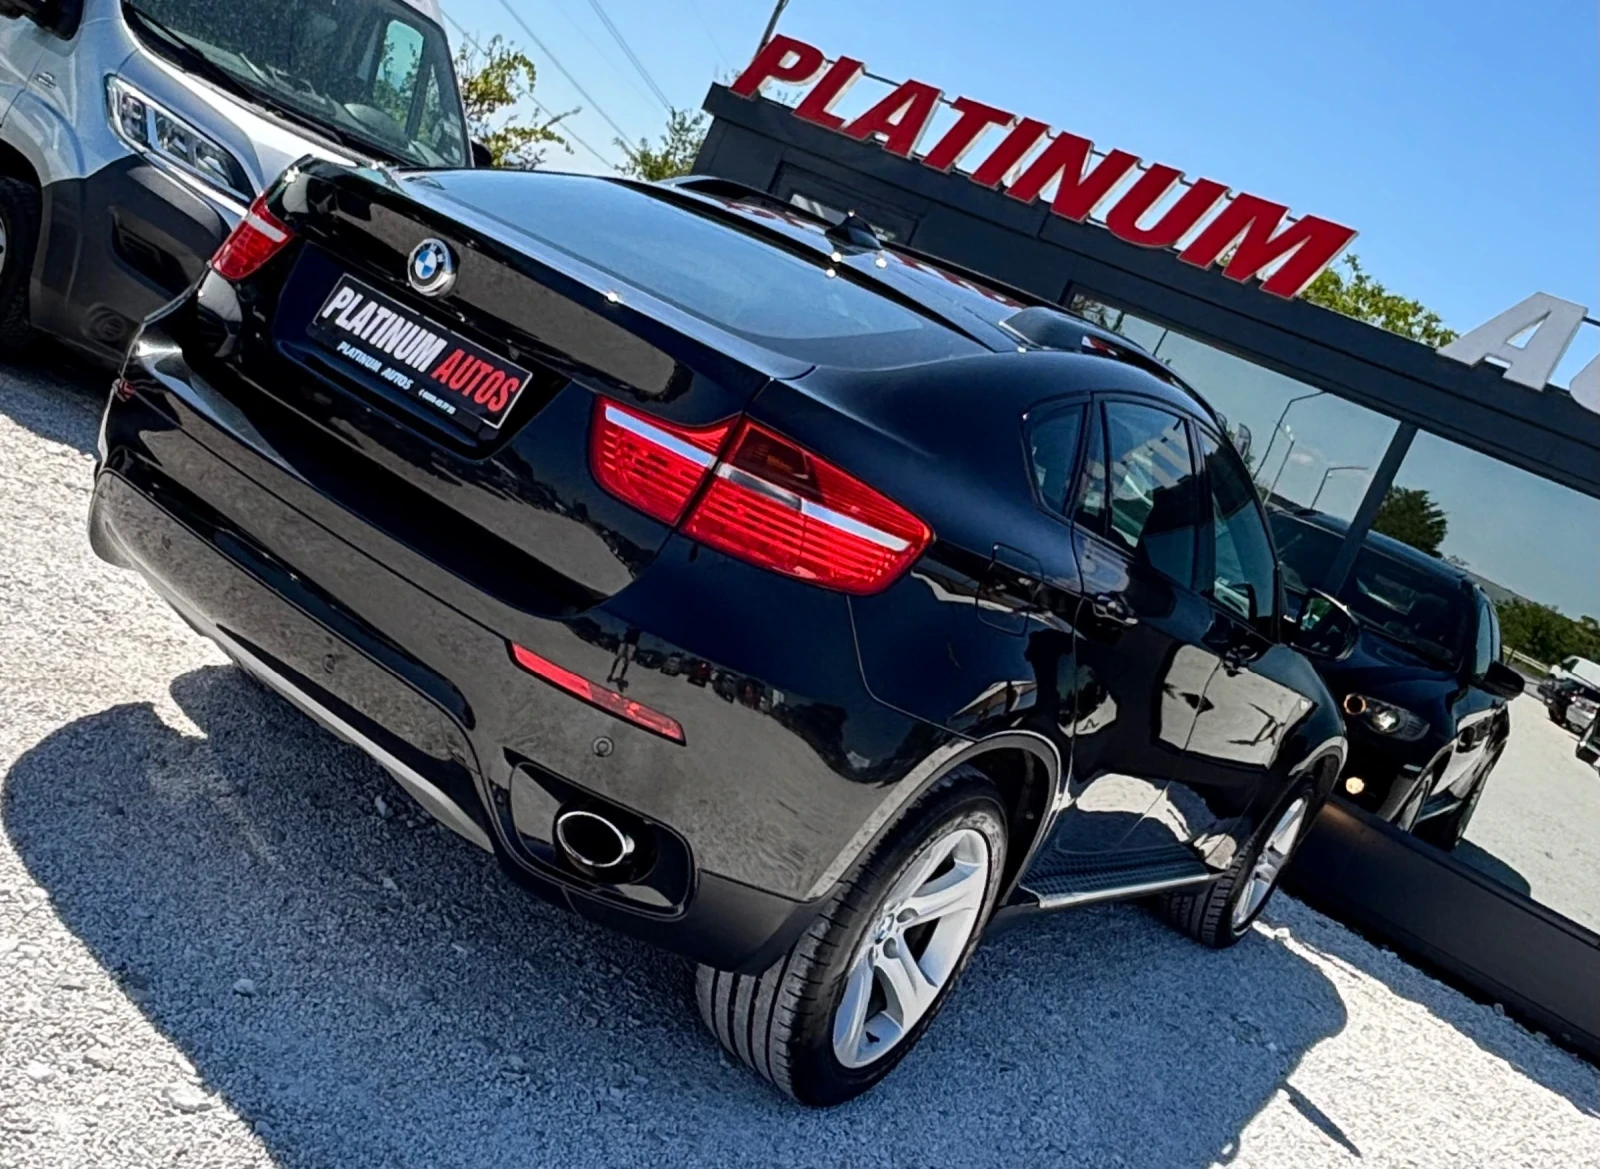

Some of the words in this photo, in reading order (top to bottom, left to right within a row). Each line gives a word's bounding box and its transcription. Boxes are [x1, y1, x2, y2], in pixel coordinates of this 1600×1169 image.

[728, 34, 1358, 299] PLATINUM
[321, 286, 448, 373] PLATINUM
[430, 348, 520, 412] AUTOS
[336, 341, 383, 373] PLATINUM
[380, 367, 415, 390] AUTOS
